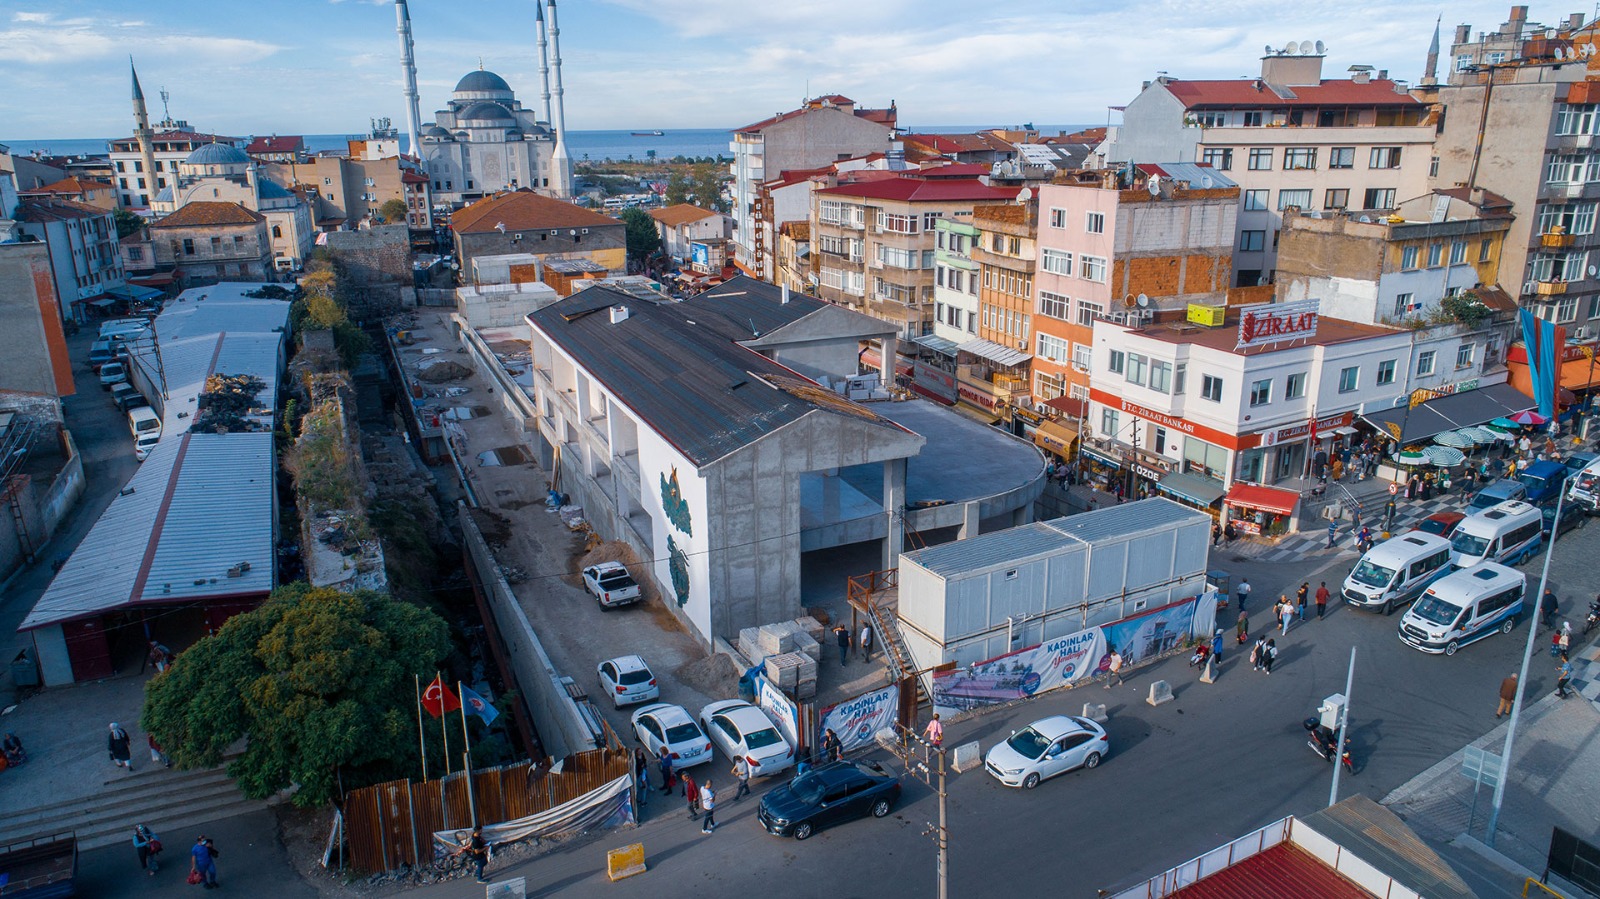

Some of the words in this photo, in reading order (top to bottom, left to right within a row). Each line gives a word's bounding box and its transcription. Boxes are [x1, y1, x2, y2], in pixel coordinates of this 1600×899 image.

[1255, 312, 1316, 337] ZİRAAT
[1127, 403, 1138, 413] T.C.
[1138, 406, 1162, 421] ZİRAAT
[1163, 416, 1195, 433] BANKASI
[1290, 425, 1310, 436] ZİRAA
[1047, 632, 1094, 653] KADINLAR
[1060, 645, 1081, 657] HALİ
[840, 692, 889, 716] KADINLAR
[854, 705, 876, 719] HALİ
